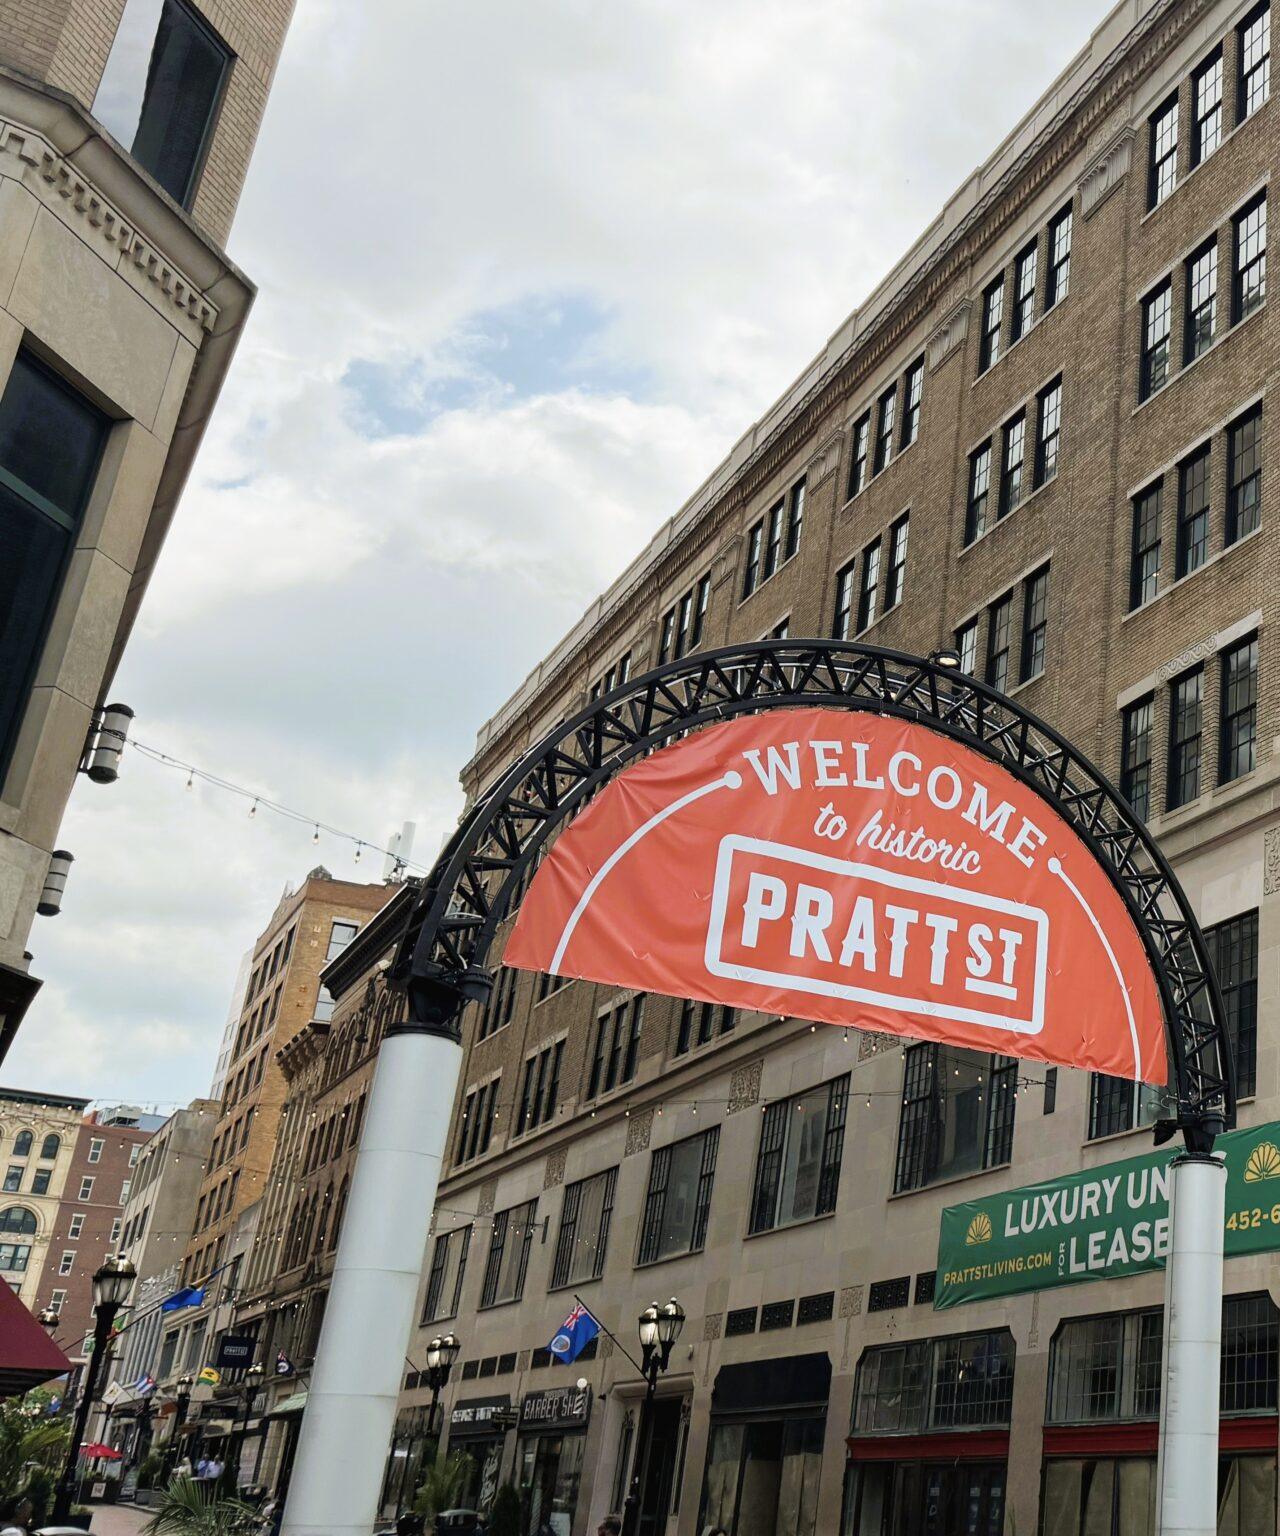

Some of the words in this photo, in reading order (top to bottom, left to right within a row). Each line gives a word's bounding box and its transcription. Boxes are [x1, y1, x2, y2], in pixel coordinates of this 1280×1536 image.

[743, 740, 1050, 868] WELCOME
[814, 801, 847, 841] to
[857, 808, 983, 875] historic
[742, 872, 957, 984] PRATT
[966, 924, 1023, 984] ST
[1004, 1175, 1122, 1238] LUXURY
[943, 1251, 1052, 1287] PRATTSTLIVING.COM
[1058, 1242, 1066, 1276] FOR
[1069, 1217, 1170, 1275] LEASE
[523, 1397, 559, 1420] BARBER
